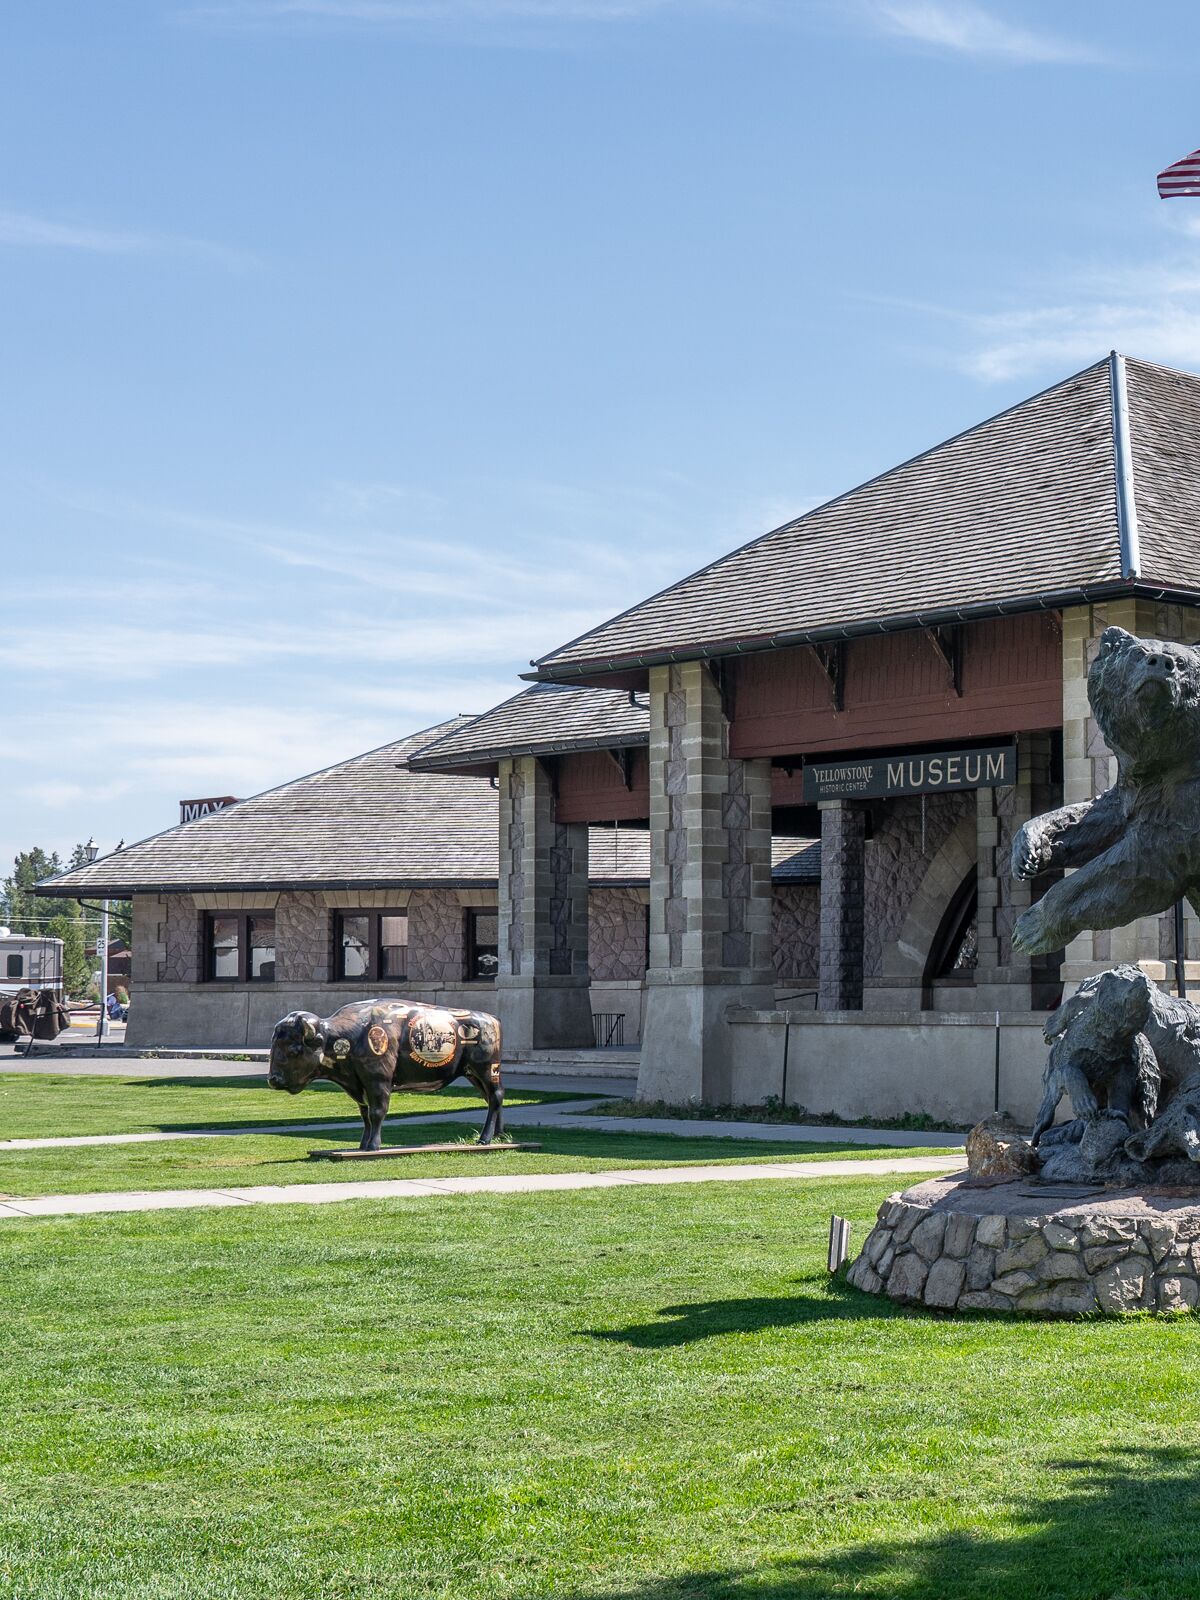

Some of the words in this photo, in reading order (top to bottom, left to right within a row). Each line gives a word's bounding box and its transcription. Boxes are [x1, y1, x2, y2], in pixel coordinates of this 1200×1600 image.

[812, 765, 873, 783] YELLOWSTONE
[887, 753, 1005, 789] MUSEUM
[819, 783, 845, 794] HISTORIC
[846, 781, 867, 792] CENTER
[97, 940, 105, 949] 25
